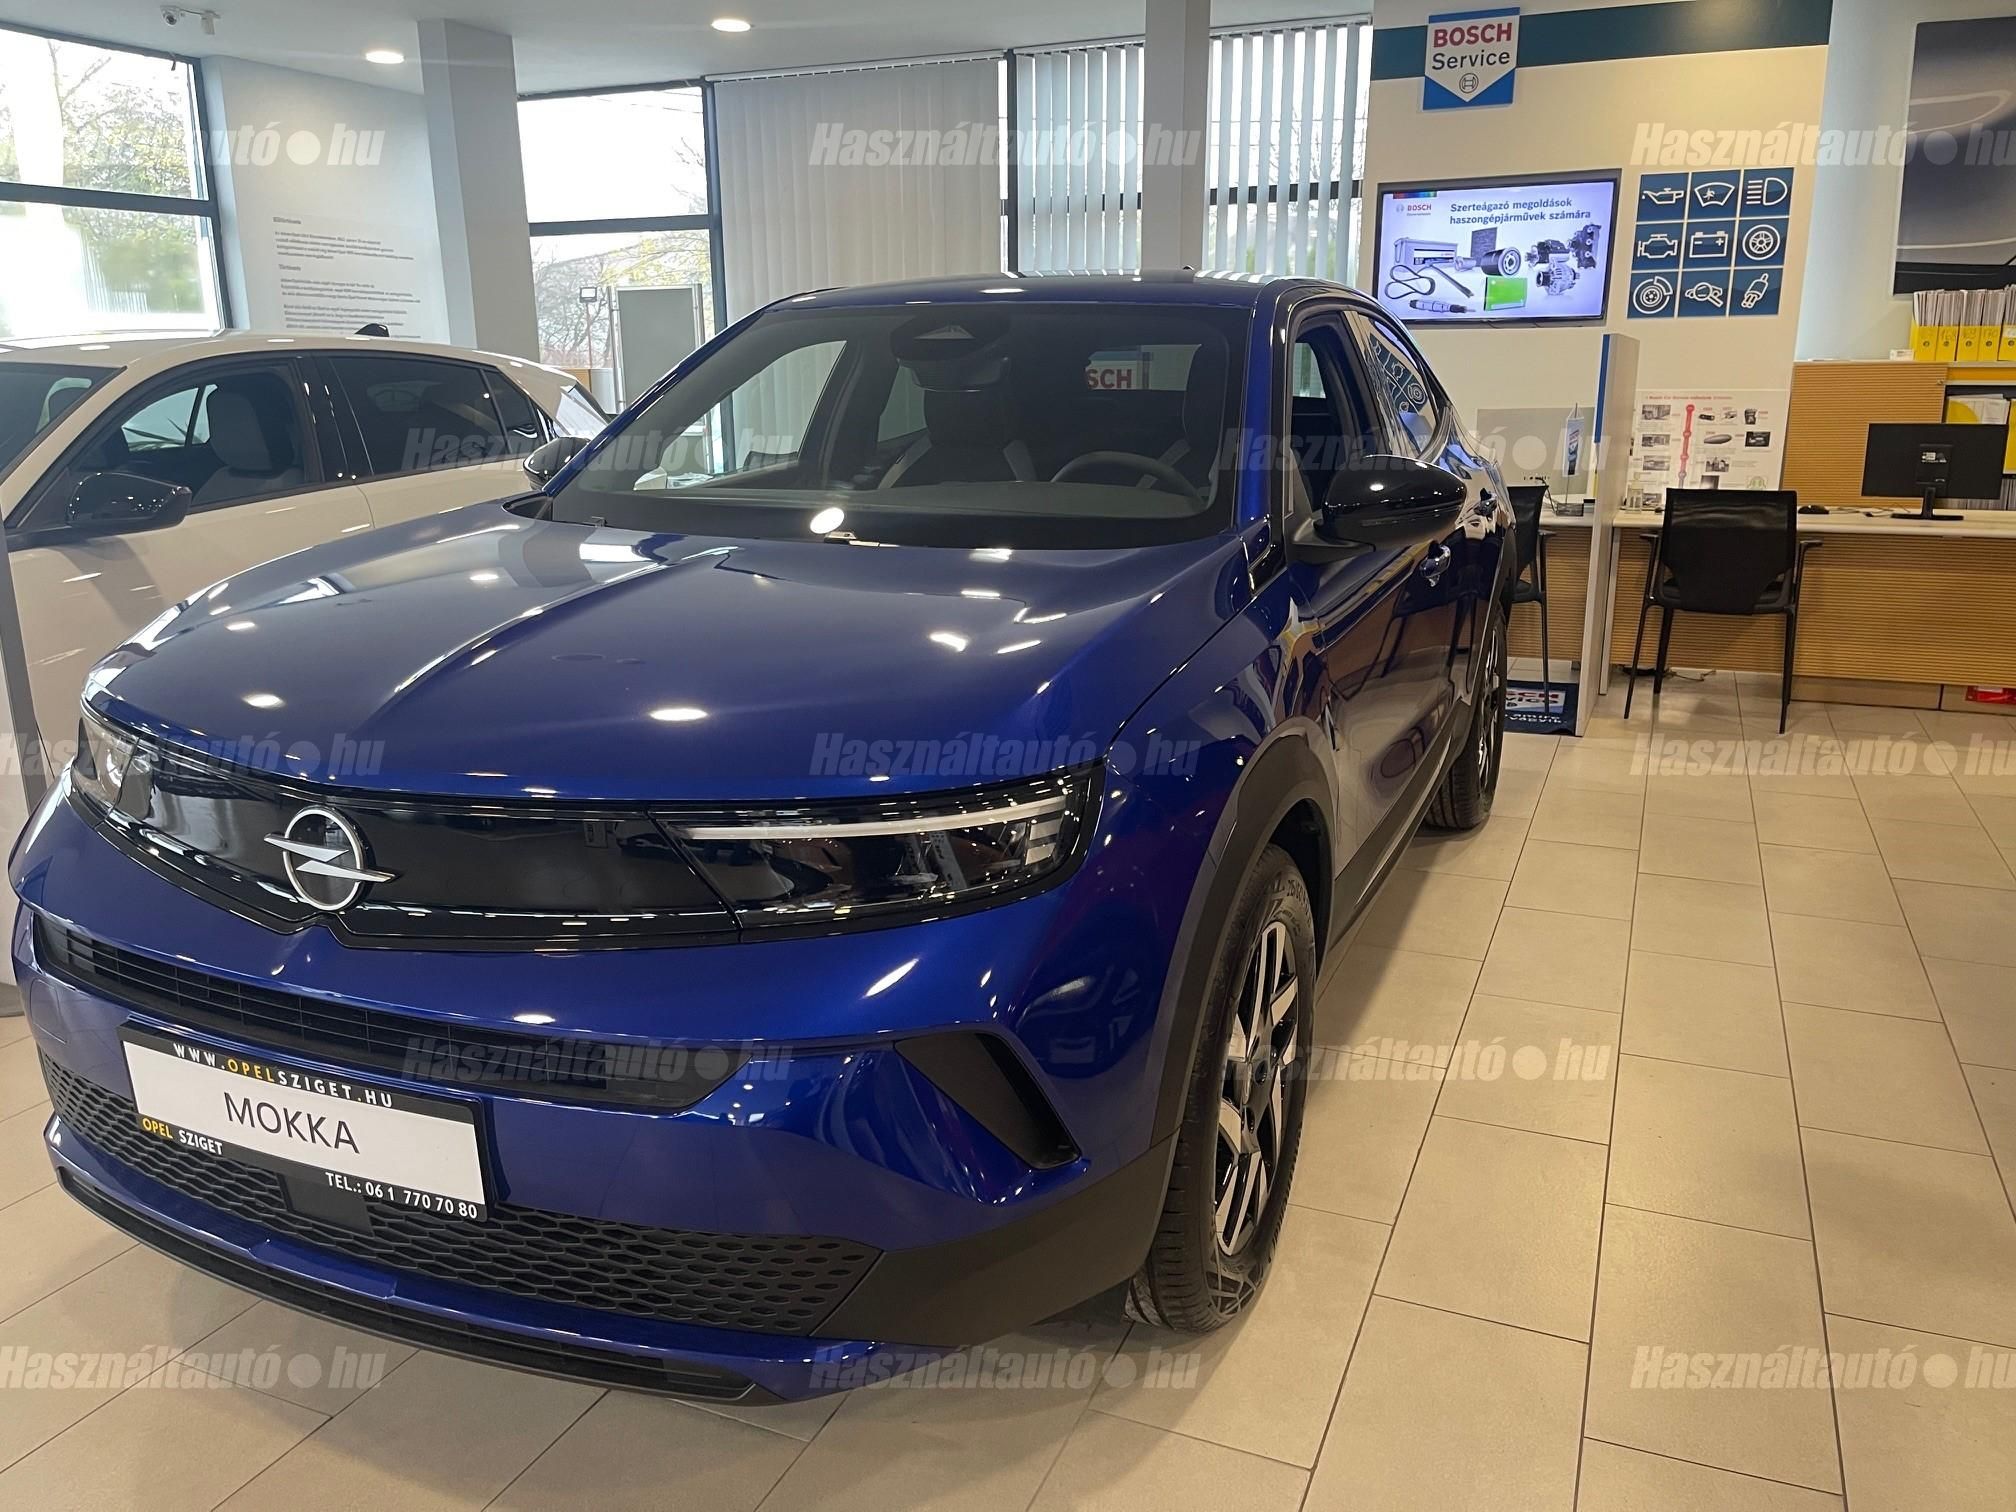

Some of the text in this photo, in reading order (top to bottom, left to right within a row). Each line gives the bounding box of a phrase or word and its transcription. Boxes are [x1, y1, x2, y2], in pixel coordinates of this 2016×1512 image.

[1433, 23, 1512, 47] BOSCH
[1432, 49, 1510, 70] Service
[1407, 203, 1432, 211] BOSCH
[1450, 197, 1573, 212] Szerteágazó megoldások
[1449, 208, 1591, 225] haszongépjárművek számára
[224, 1092, 360, 1154] MOKKA
[142, 1117, 223, 1155] OPEL SZIGET
[325, 1172, 478, 1219] TEL.: 06 1 770 70 80
